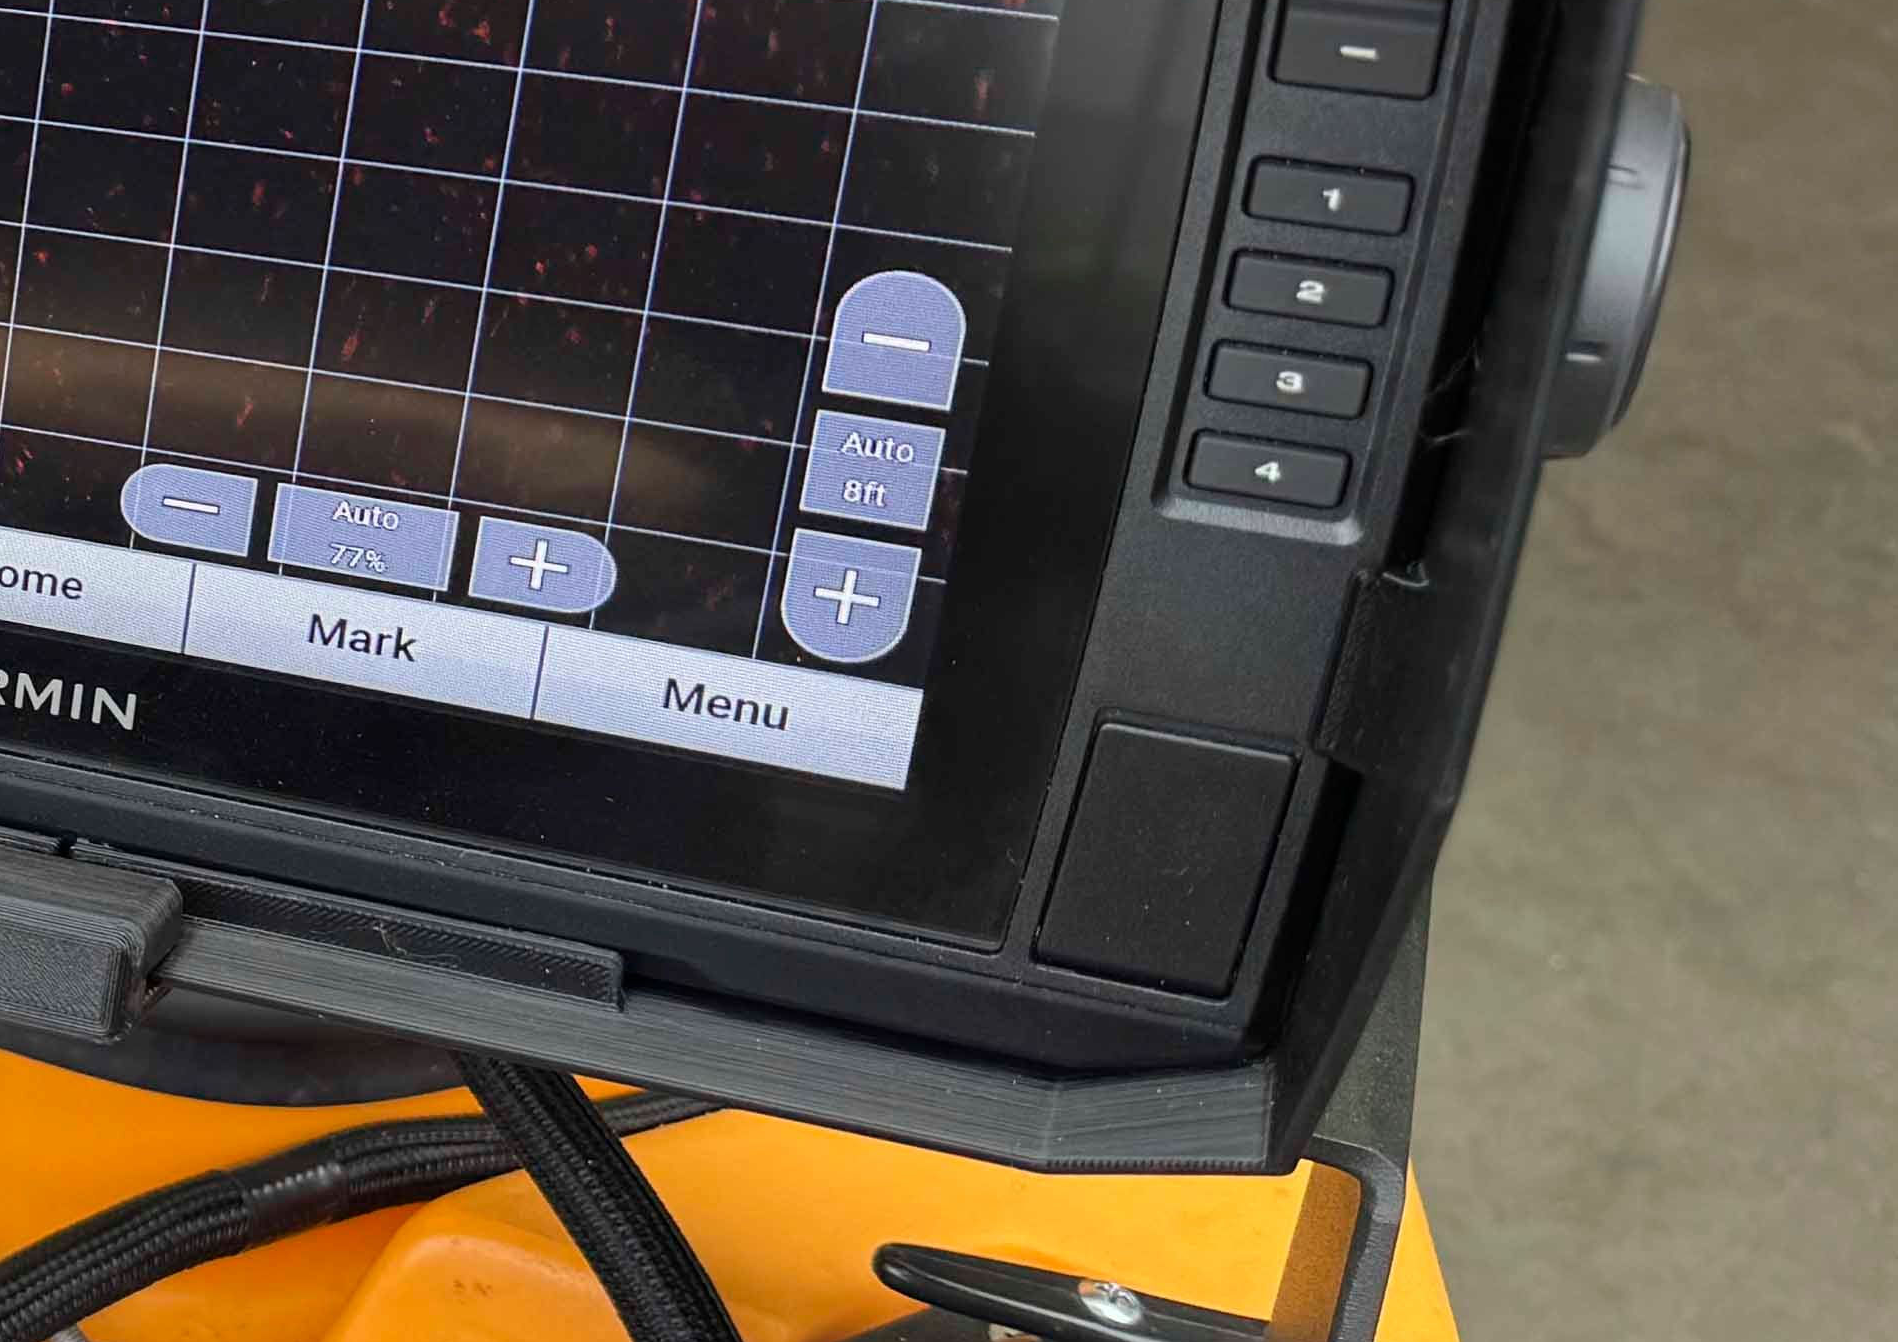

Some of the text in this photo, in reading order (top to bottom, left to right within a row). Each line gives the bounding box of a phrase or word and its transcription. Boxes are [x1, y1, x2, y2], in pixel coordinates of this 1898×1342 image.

[1322, 187, 1341, 211] 1
[1297, 279, 1325, 303] 2
[1276, 370, 1304, 395] 3
[840, 431, 914, 465] Auto
[1255, 462, 1282, 483] 4
[842, 479, 887, 508] 8ft
[332, 500, 399, 531] Auto
[328, 542, 387, 574] 77%
[306, 614, 417, 663] Mark
[662, 677, 790, 732] Menu
